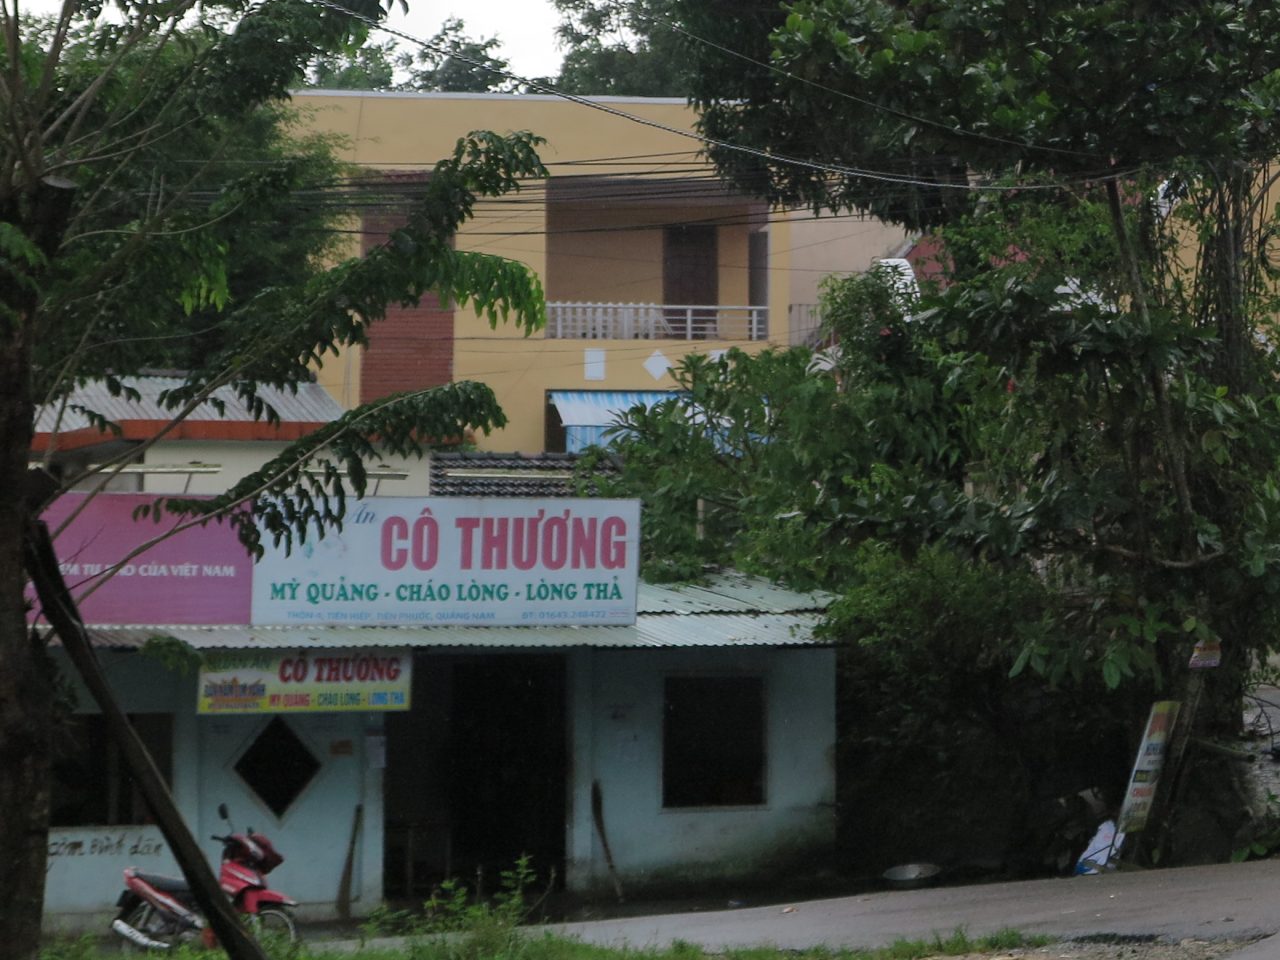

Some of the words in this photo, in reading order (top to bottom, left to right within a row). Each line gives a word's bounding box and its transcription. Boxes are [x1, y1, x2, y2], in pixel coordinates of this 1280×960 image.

[380, 506, 439, 571] CÔ
[454, 508, 627, 571] THƯƠNG
[202, 564, 236, 577] NAM
[270, 578, 300, 601] MỲ
[306, 576, 379, 605] QUẢNG
[395, 579, 451, 602] CHÁO
[456, 579, 509, 602] LÒNG
[526, 578, 578, 601] LÒNG
[583, 575, 623, 601] THẢ
[278, 651, 309, 683] CÔ
[314, 652, 402, 683] THƯƠNG
